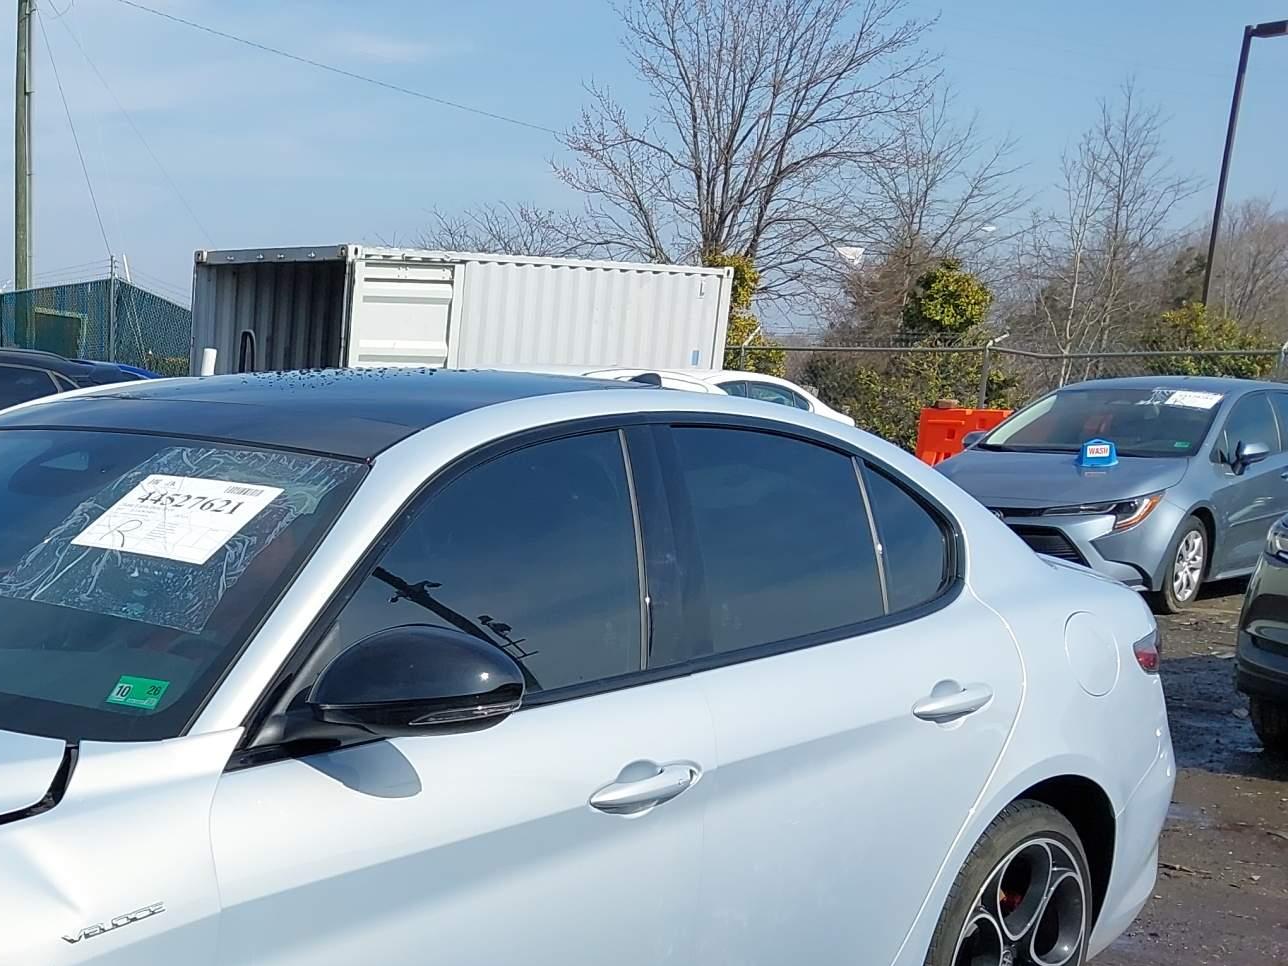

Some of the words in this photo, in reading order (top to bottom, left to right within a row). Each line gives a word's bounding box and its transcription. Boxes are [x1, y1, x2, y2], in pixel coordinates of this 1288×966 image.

[1088, 446, 1109, 455] WASH
[137, 491, 244, 515] 44527621
[115, 684, 132, 698] 10
[146, 685, 162, 696] 26
[61, 901, 167, 944] VELOCE
